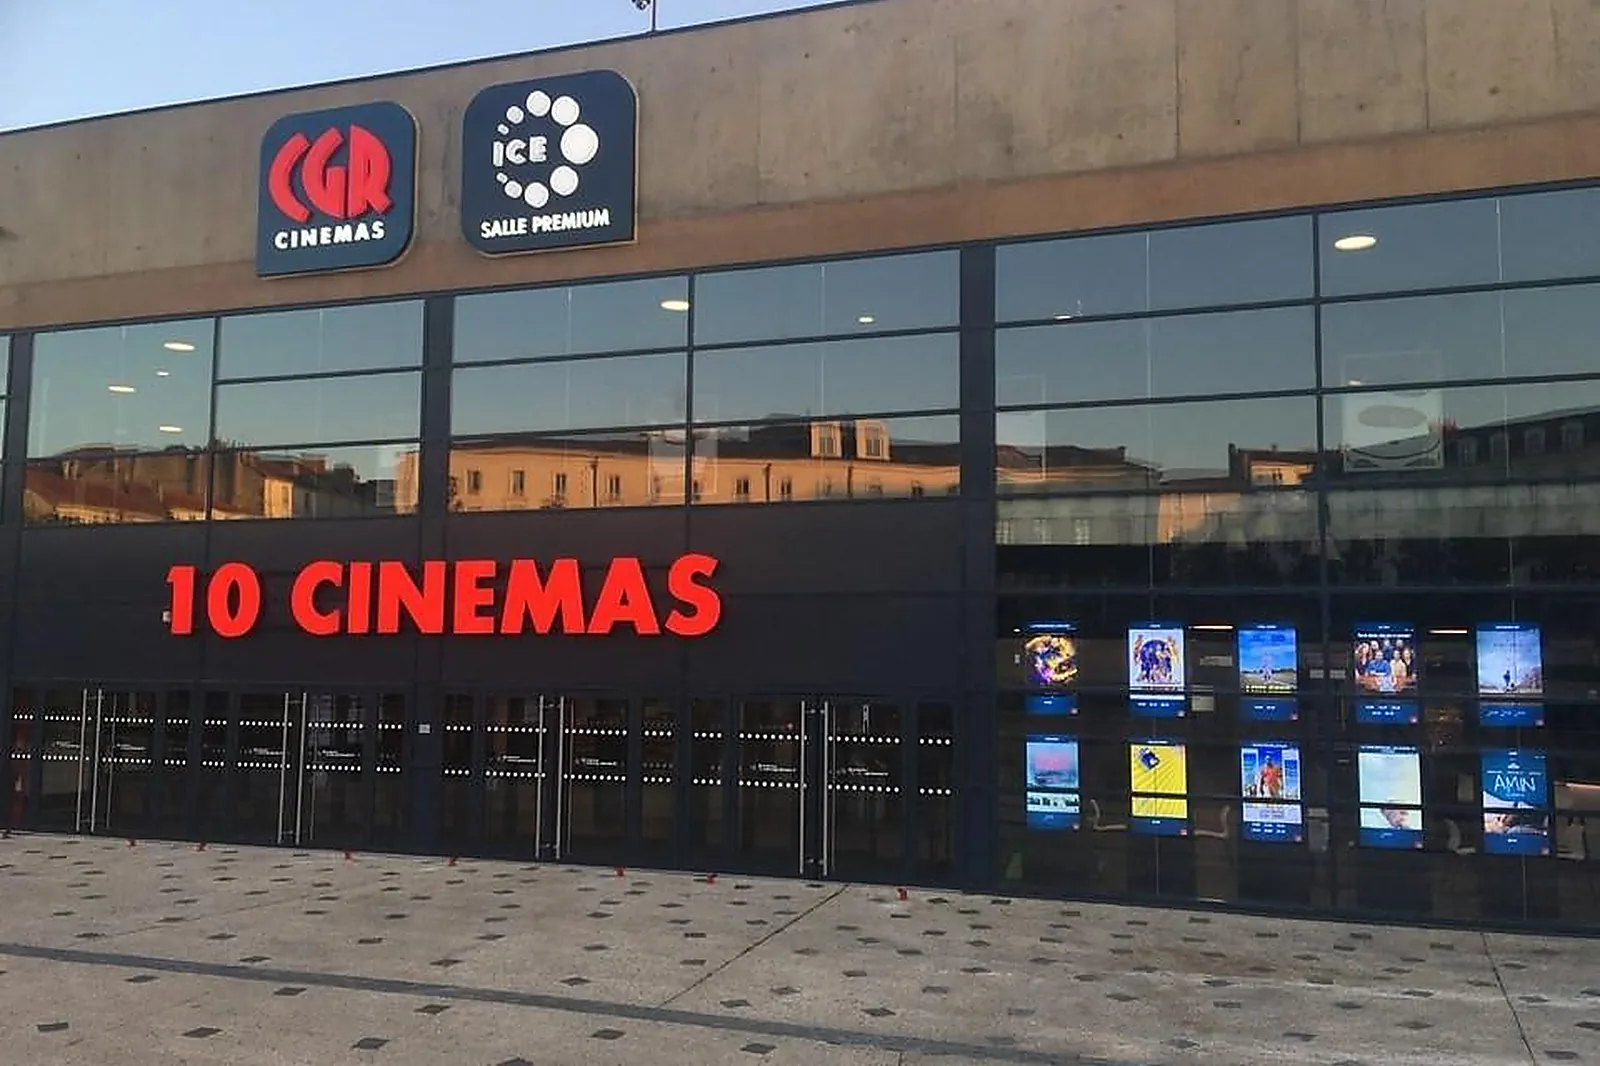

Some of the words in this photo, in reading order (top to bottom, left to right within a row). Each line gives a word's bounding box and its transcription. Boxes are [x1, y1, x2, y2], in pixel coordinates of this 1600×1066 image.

[493, 136, 549, 167] ICE
[268, 124, 394, 223] CGR
[274, 220, 386, 250] CINEMAS
[480, 217, 528, 239] SALLE
[532, 208, 611, 234] PREMIUM
[166, 562, 262, 638] 10
[291, 553, 722, 637] CINEMAS
[1494, 774, 1536, 793] AMIN
